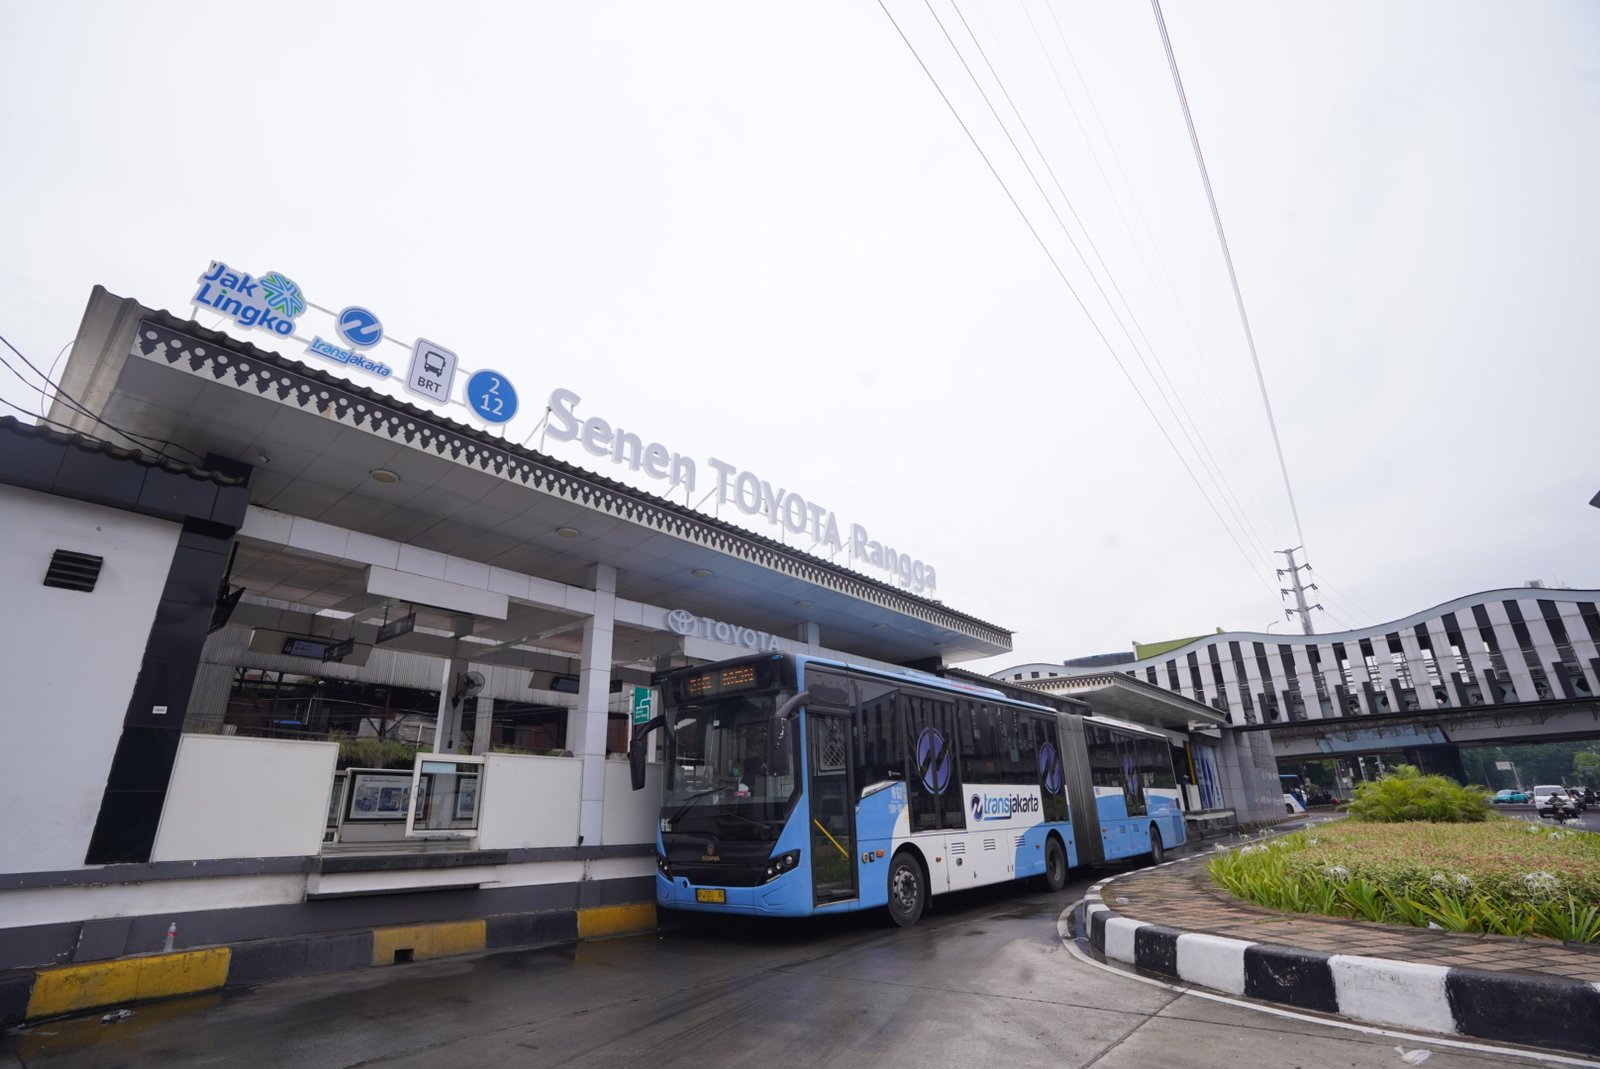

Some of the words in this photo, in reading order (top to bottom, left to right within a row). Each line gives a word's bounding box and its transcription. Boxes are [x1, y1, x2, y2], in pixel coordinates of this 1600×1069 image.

[203, 262, 257, 297] Jak
[195, 283, 293, 336] Lingko
[311, 338, 391, 378] transjakarta
[417, 376, 442, 394] BRT
[489, 377, 500, 395] 2
[480, 394, 503, 416] 12
[544, 387, 697, 493] Senen
[706, 456, 843, 552] TOYOTA
[850, 522, 937, 595] Rangga
[701, 617, 781, 651] TOYOTA
[983, 793, 1039, 819] transjakarta
